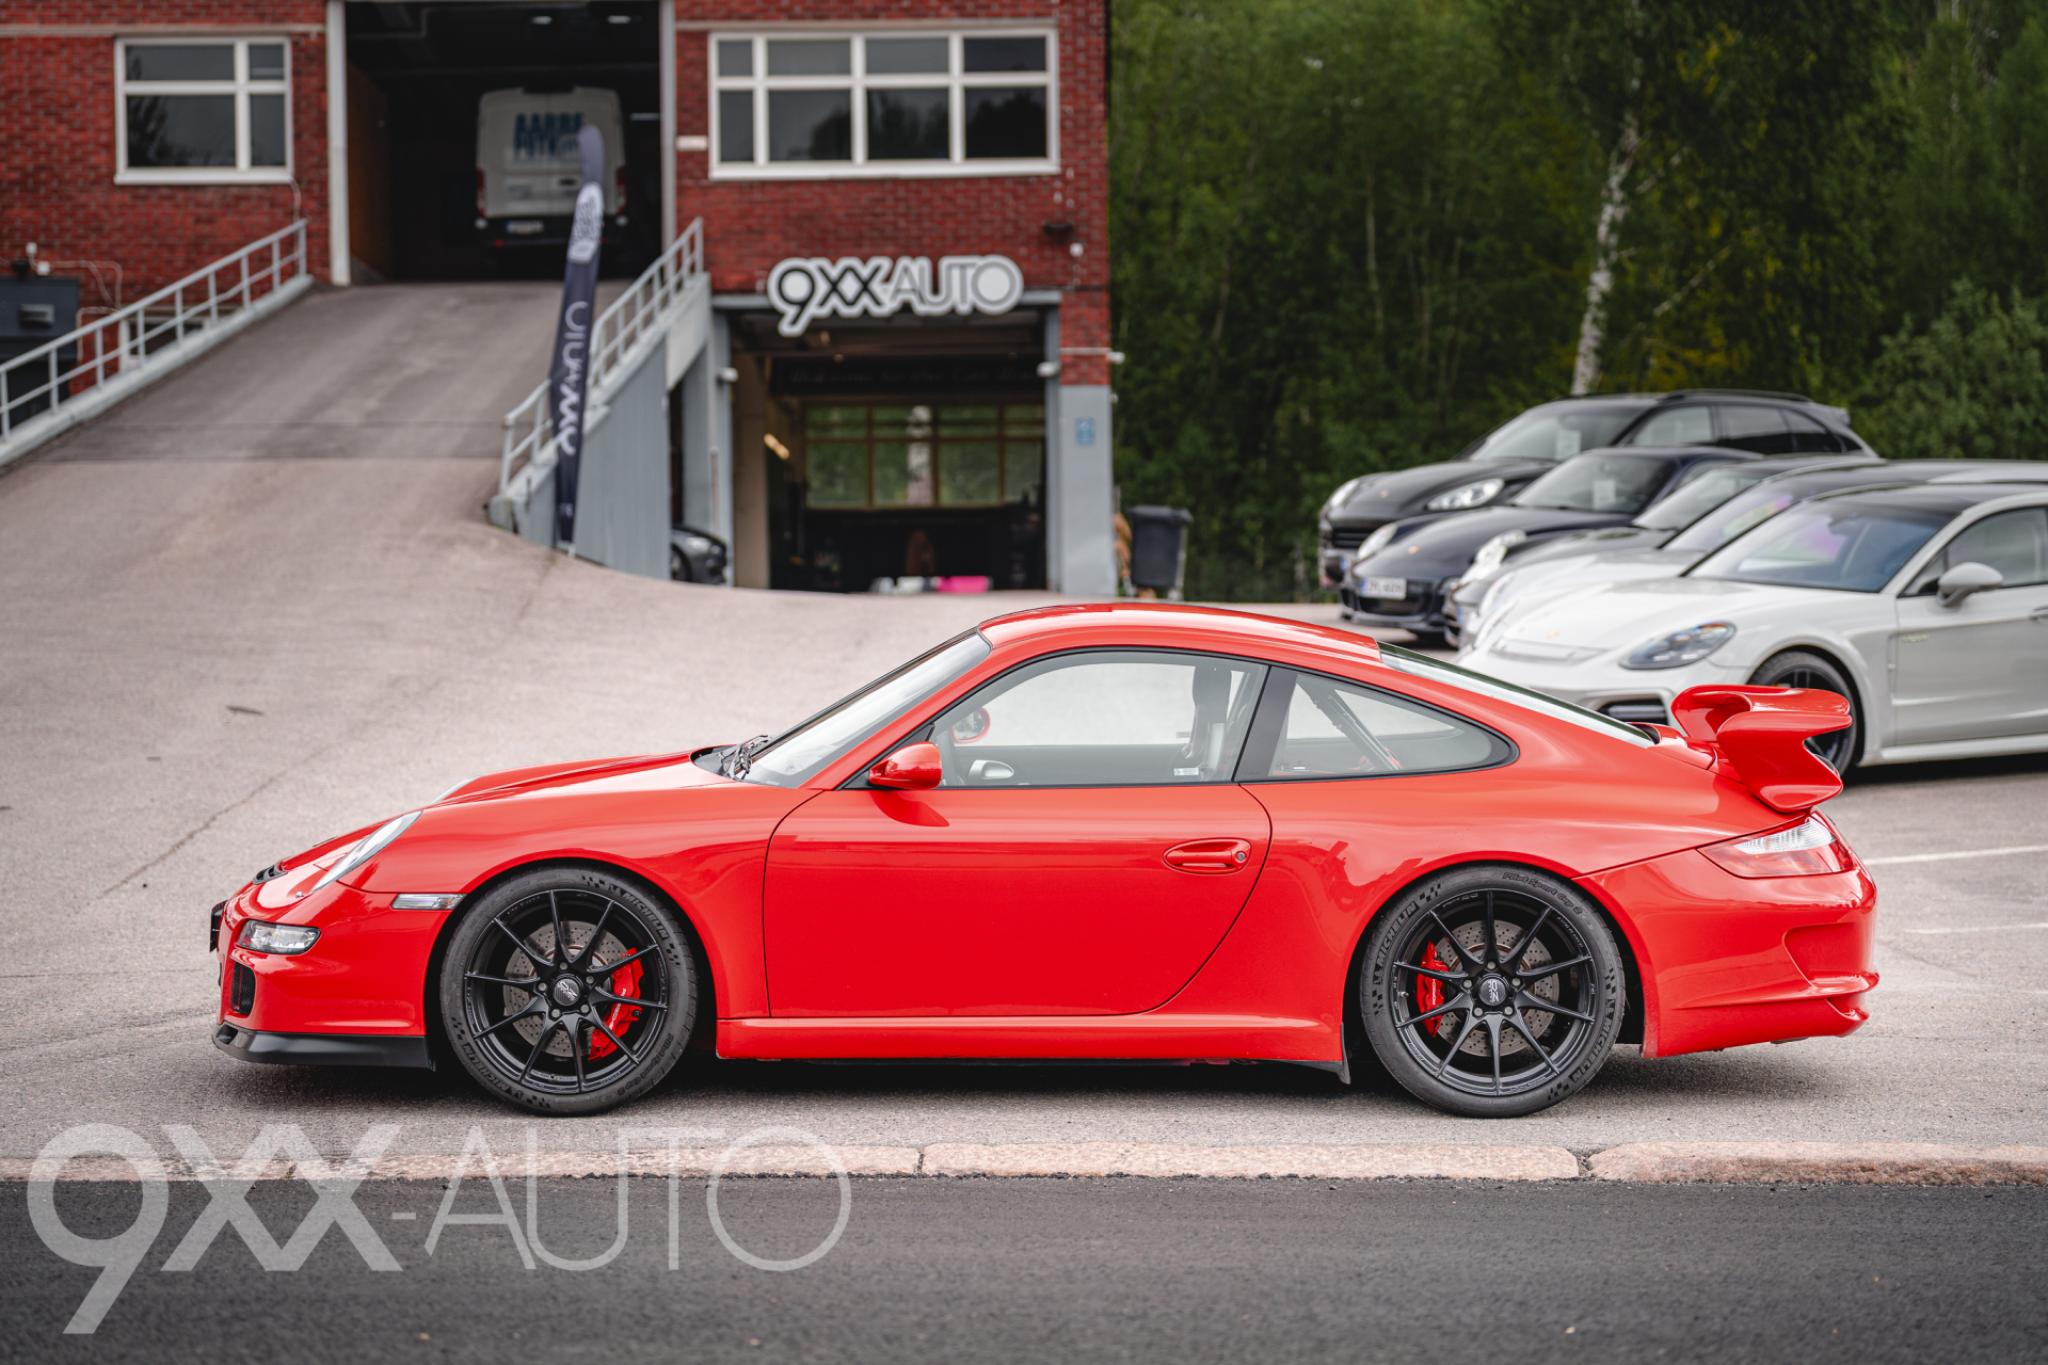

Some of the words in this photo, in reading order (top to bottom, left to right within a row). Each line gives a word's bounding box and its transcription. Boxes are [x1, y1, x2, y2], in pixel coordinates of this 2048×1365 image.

[622, 892, 670, 940] MICHELIN
[1376, 901, 1419, 968] MICHELIN
[1569, 1017, 1613, 1082] MICHELIN
